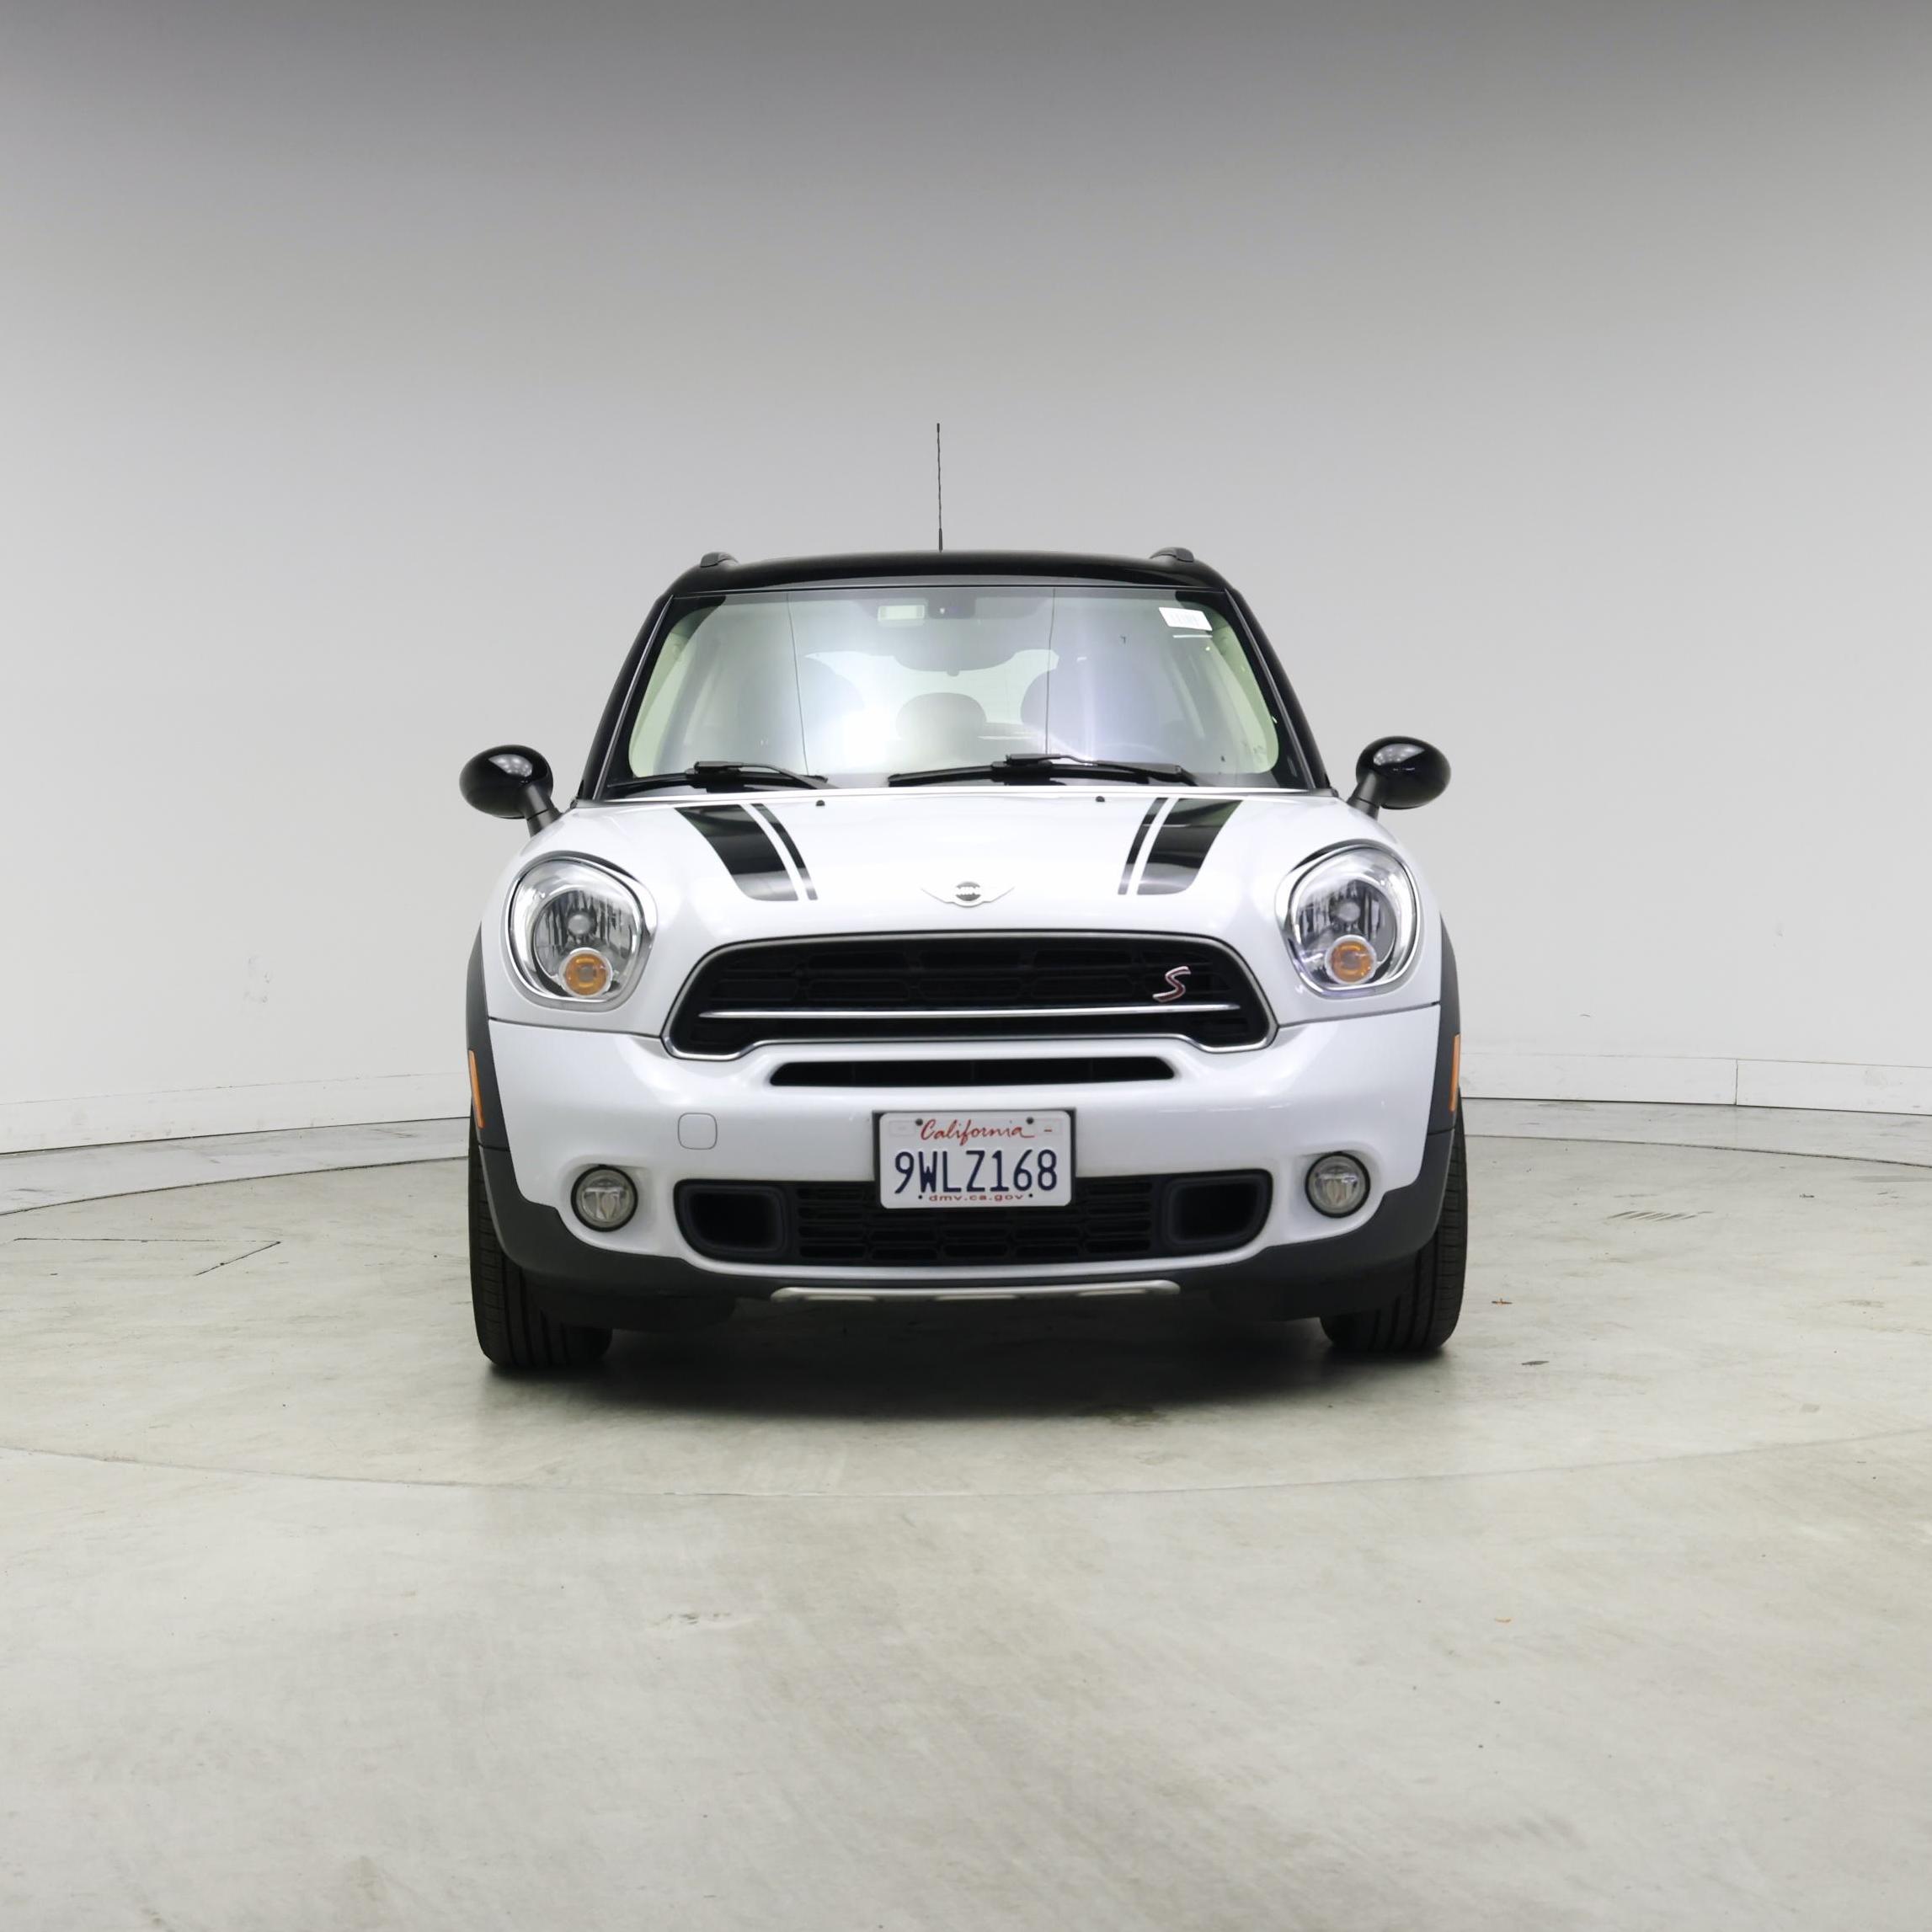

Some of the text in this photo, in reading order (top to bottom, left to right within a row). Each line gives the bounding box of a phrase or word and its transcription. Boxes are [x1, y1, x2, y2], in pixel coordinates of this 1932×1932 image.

[1152, 966, 1192, 1002] S
[921, 1119, 1034, 1145] California
[894, 1149, 1057, 1193] 9WLZ168
